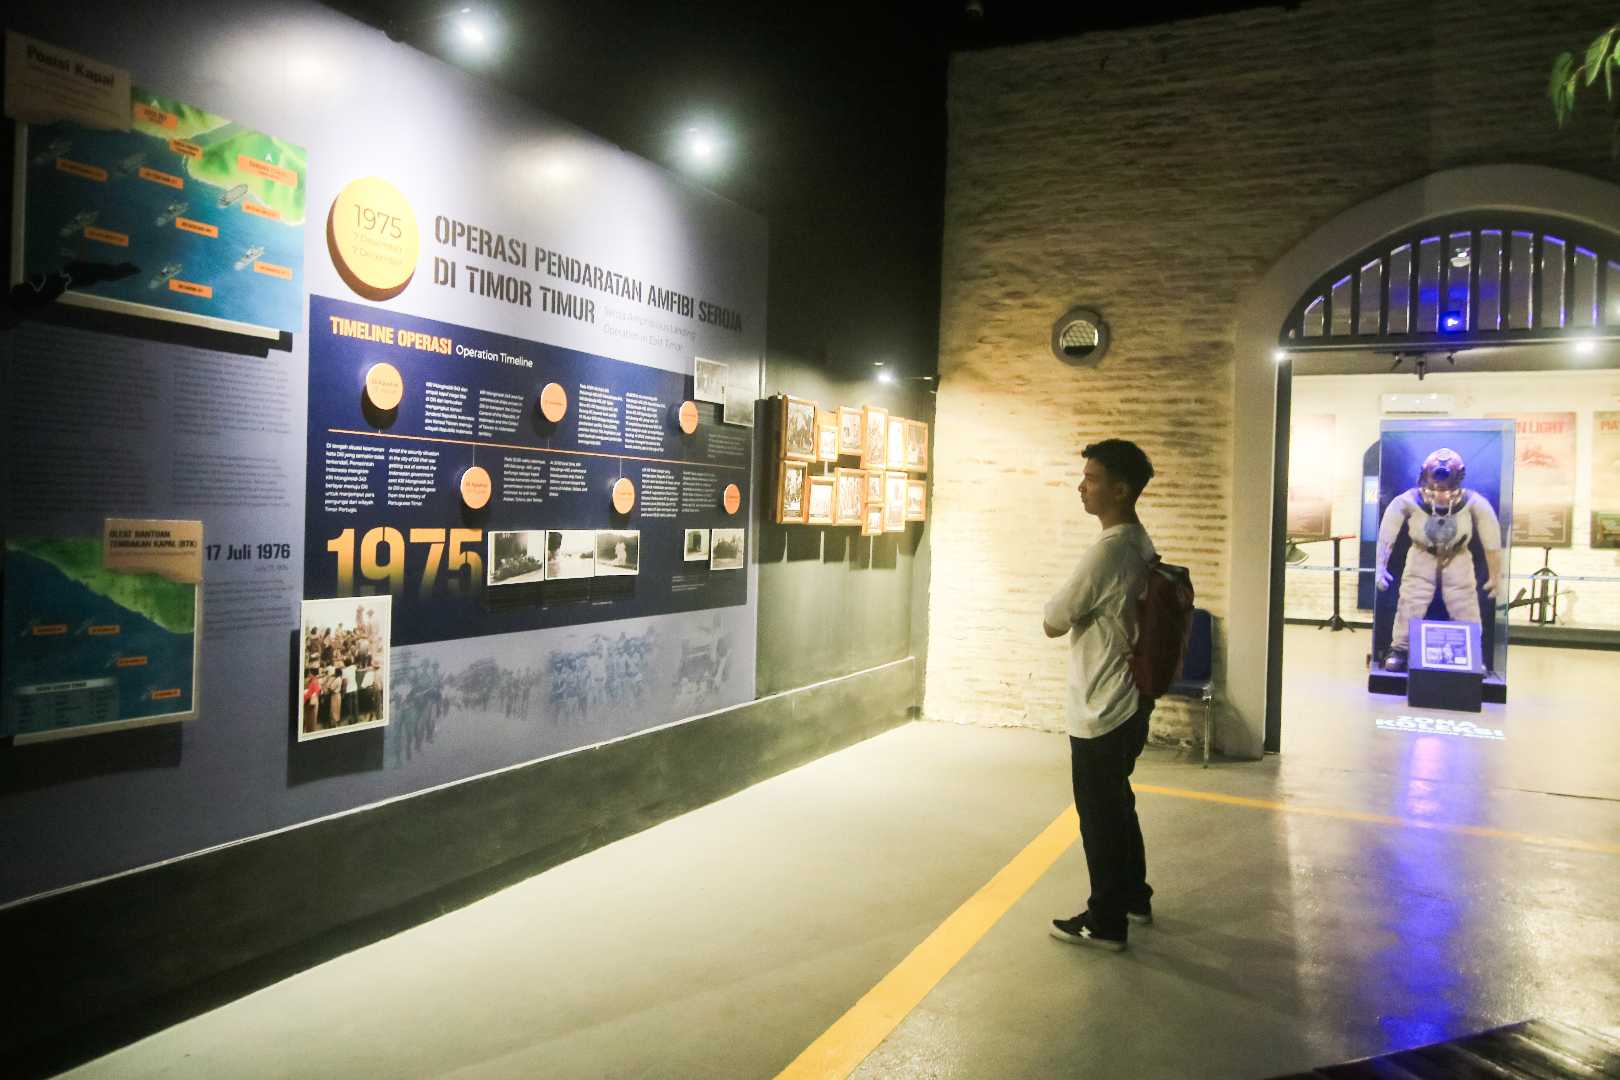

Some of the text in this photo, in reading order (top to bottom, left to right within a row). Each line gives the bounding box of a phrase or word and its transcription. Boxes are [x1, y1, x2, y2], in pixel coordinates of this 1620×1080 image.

[75, 64, 114, 87] Kapal
[353, 204, 402, 239] 1975
[435, 215, 742, 332] OPERASI PENDARATAN AMFIBI SEROJA
[434, 256, 595, 324] DI TIMOR TIMUR
[329, 316, 452, 355] TIMELINE OPERASI
[456, 345, 534, 368] Operation Timeline
[134, 530, 171, 538] BANTUAN
[153, 540, 177, 548] KAPAL
[206, 544, 221, 561] 17
[227, 544, 252, 561] Juli
[257, 543, 290, 560] 1976
[326, 526, 484, 600] 1975
